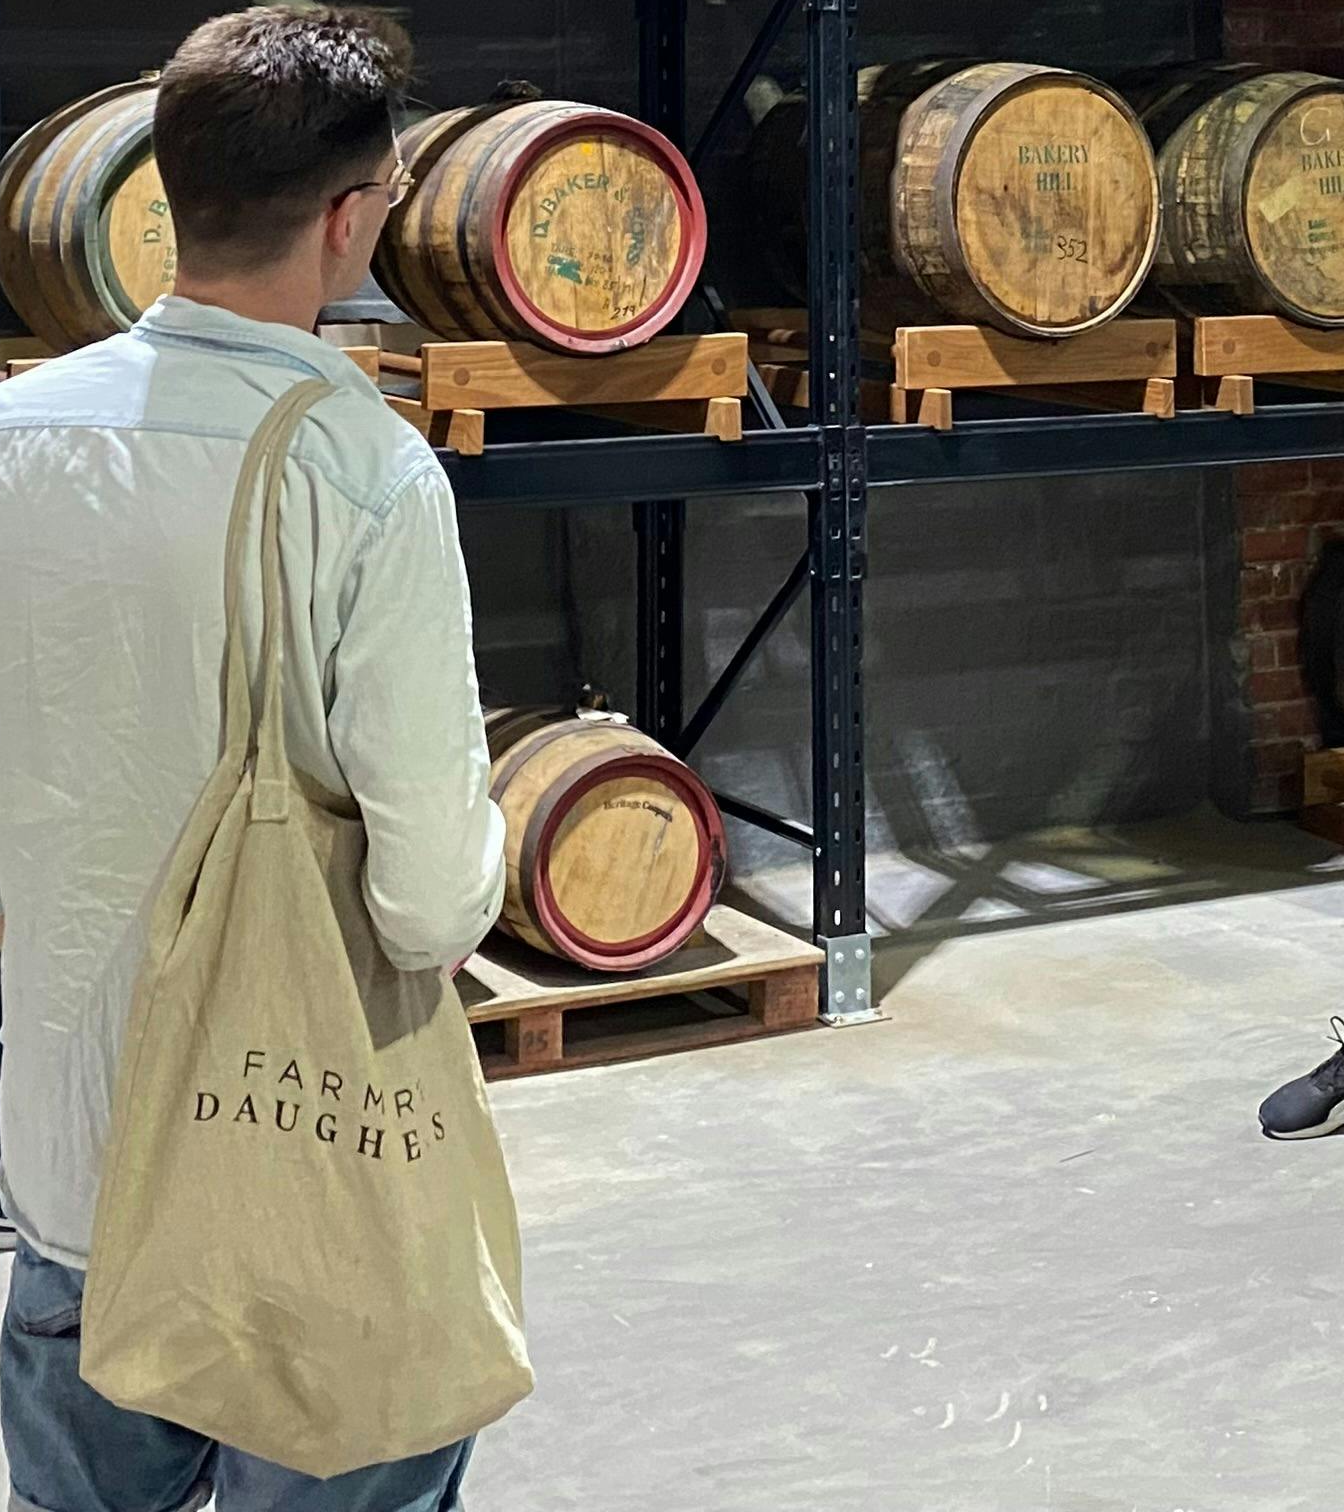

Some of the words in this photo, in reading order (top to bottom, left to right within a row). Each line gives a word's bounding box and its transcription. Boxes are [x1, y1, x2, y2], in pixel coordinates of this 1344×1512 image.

[1018, 144, 1089, 164] BAKERY
[1036, 172, 1075, 191] HILL
[539, 173, 610, 217] BAKER
[1057, 235, 1089, 264] 352
